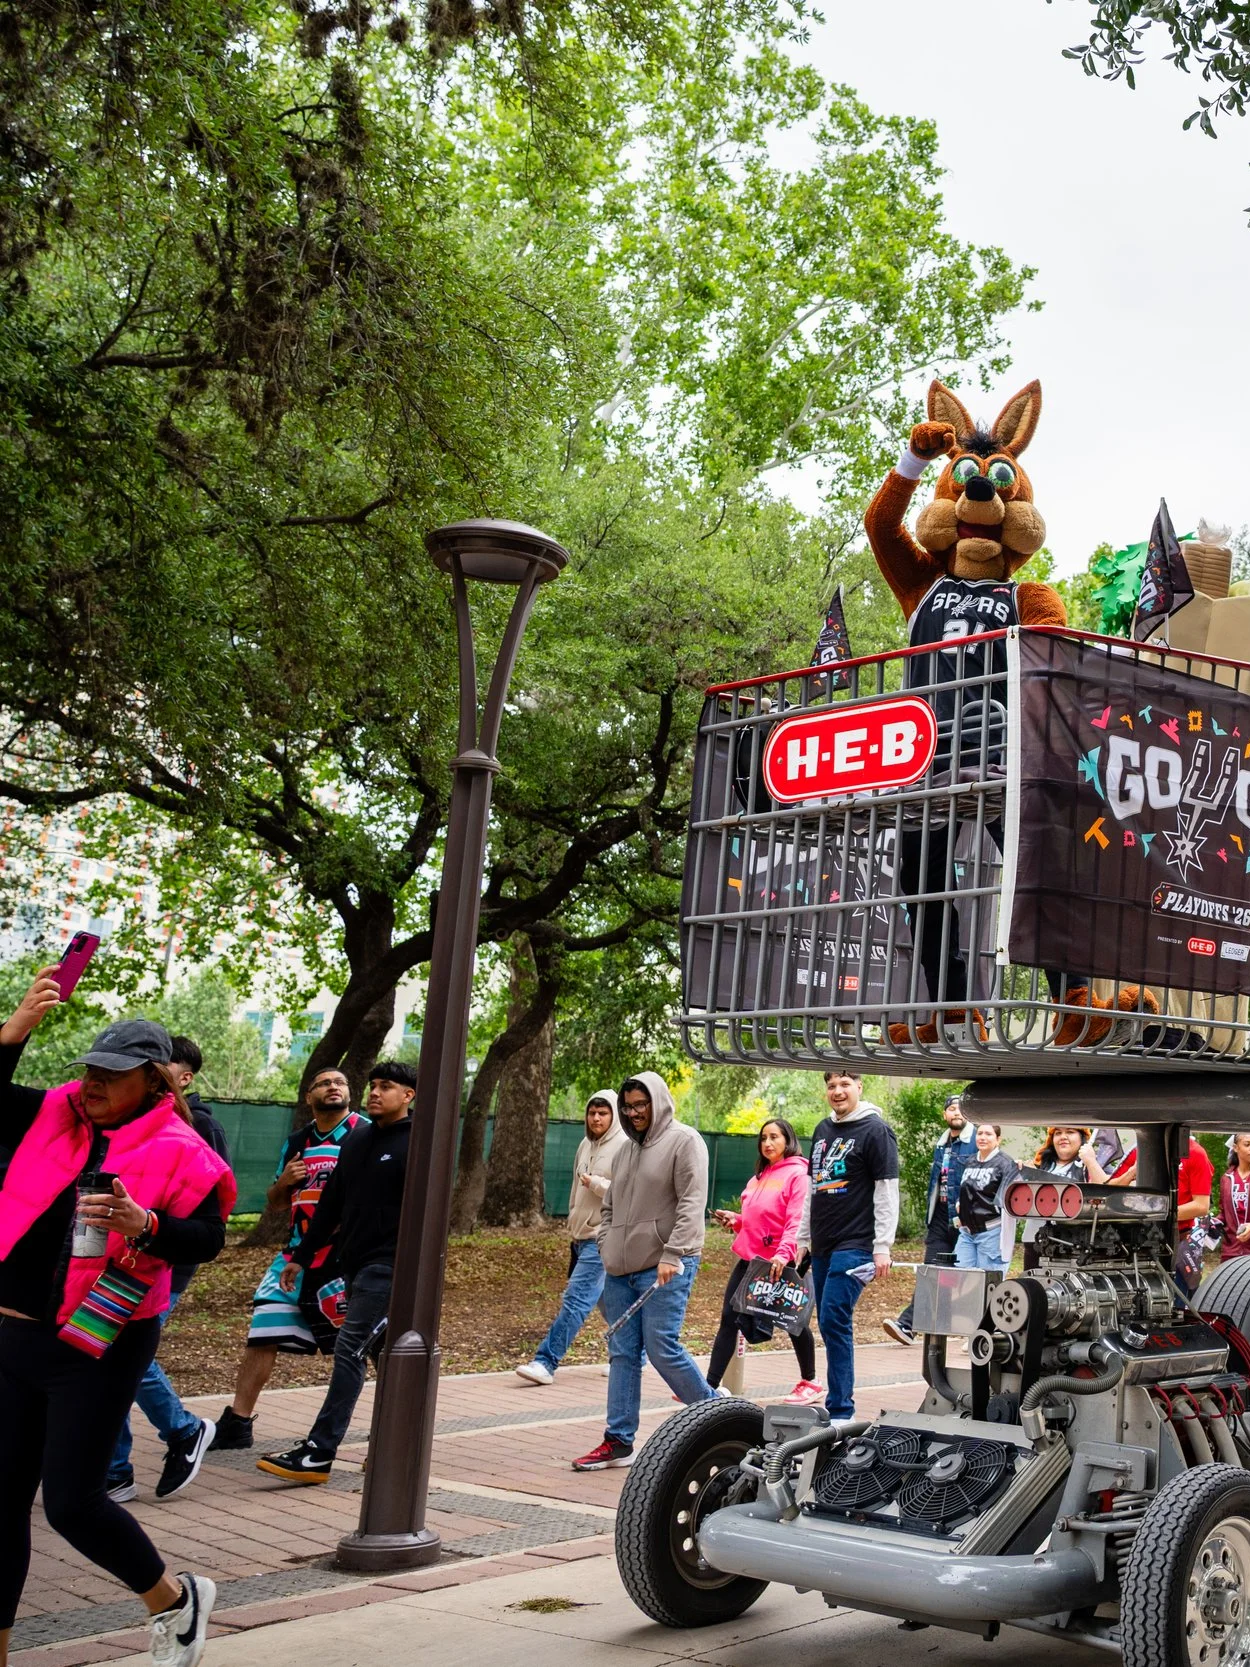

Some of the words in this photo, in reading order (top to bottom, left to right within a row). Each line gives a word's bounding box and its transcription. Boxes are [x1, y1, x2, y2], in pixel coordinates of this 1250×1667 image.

[1105, 734, 1183, 821] GO
[1161, 891, 1229, 922] PLAYOFFS
[1225, 946, 1244, 956] LEDGER
[752, 1280, 773, 1296] GO
[783, 1287, 804, 1307] GO
